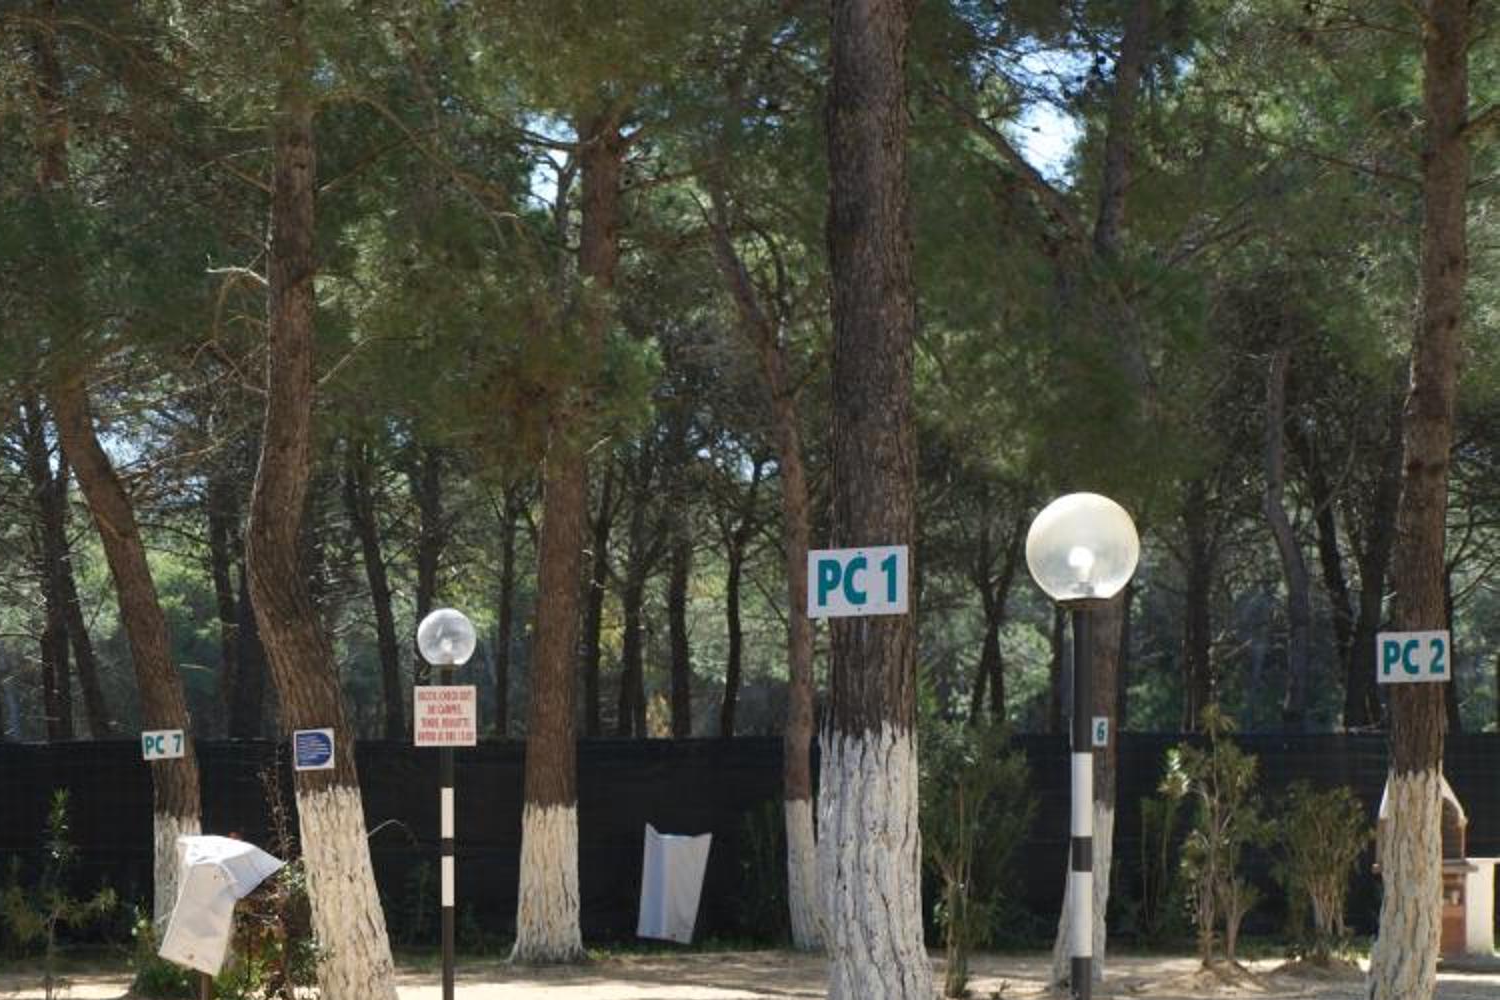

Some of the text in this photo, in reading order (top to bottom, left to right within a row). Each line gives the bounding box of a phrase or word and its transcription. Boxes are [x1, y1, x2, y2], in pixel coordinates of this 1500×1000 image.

[817, 554, 897, 606] PC 1
[1384, 638, 1445, 674] PC 2
[144, 734, 182, 755] PC 7
[1097, 721, 1105, 741] 6
